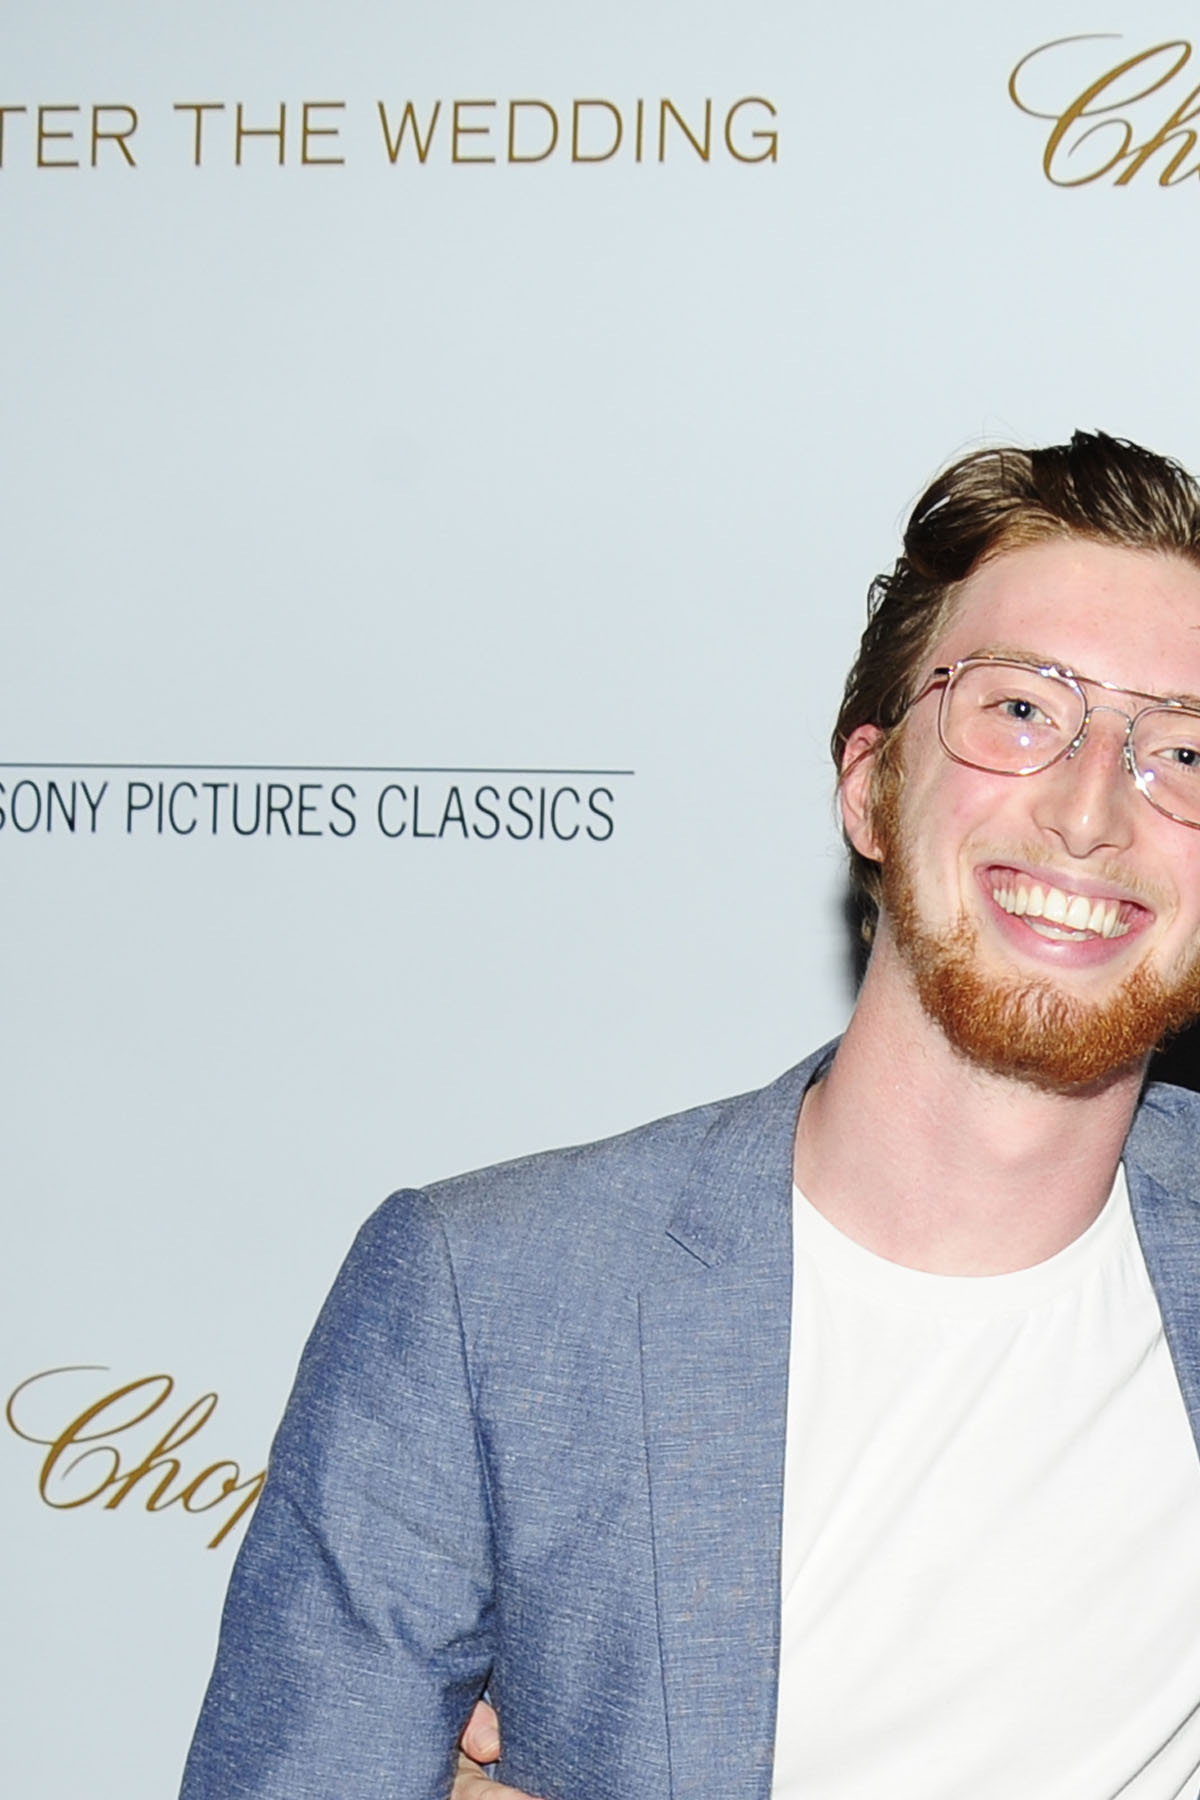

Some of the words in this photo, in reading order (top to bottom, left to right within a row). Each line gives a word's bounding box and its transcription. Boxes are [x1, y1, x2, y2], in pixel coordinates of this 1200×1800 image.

[173, 101, 346, 167] THE
[377, 96, 778, 165] WEDDING
[0, 780, 108, 833] ONY
[127, 781, 356, 837] PICTURES
[378, 784, 614, 841] CLASSICS
